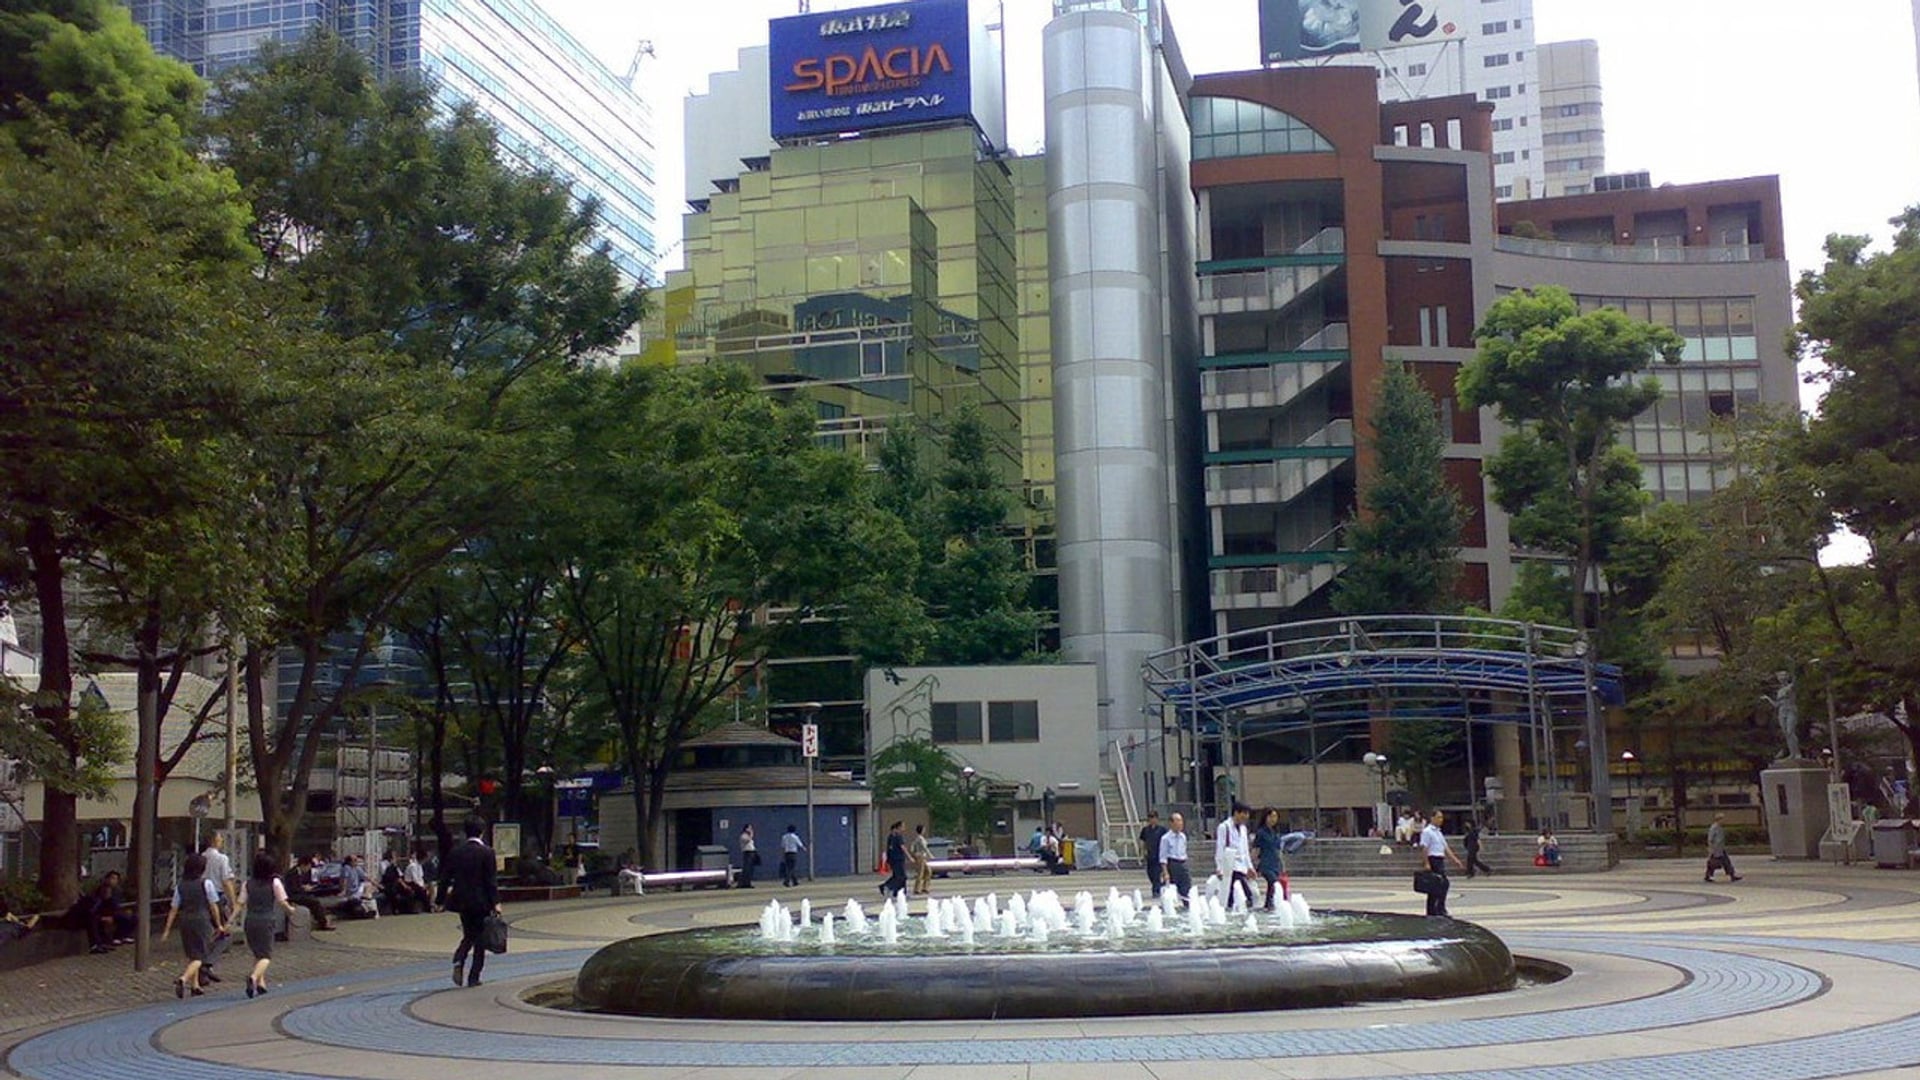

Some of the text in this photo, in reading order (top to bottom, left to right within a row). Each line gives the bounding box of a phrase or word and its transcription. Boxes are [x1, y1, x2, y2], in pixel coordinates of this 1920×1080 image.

[785, 43, 952, 95] SPACIA
[805, 726, 816, 754] トイレ
